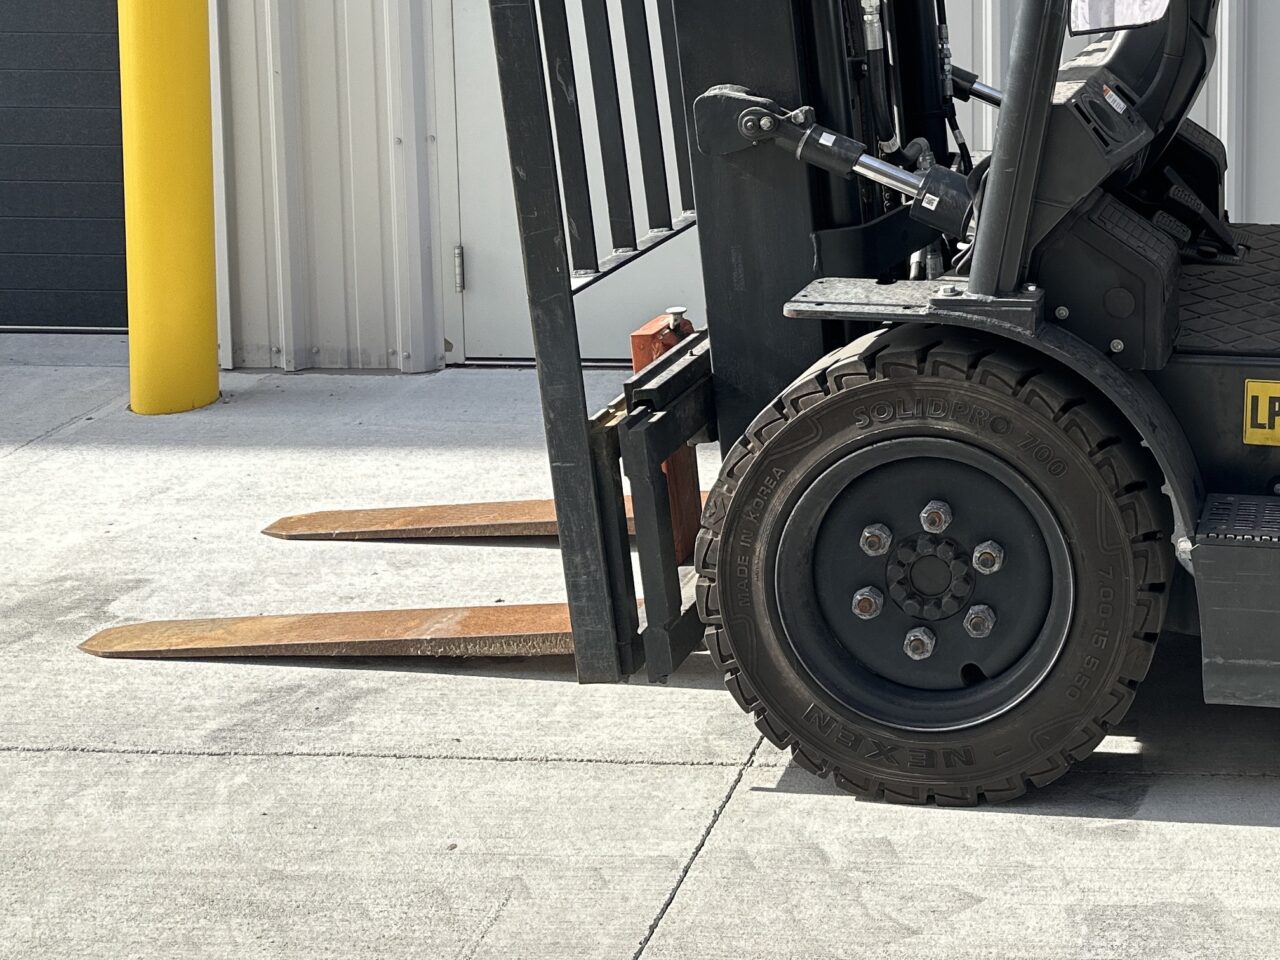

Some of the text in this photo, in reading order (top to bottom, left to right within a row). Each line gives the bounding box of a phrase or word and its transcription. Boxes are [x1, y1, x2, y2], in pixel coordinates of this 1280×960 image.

[852, 397, 1069, 478] SOLIDPRO 700
[737, 467, 786, 607] MADE IN KOREA
[801, 703, 976, 769] NEXEN
